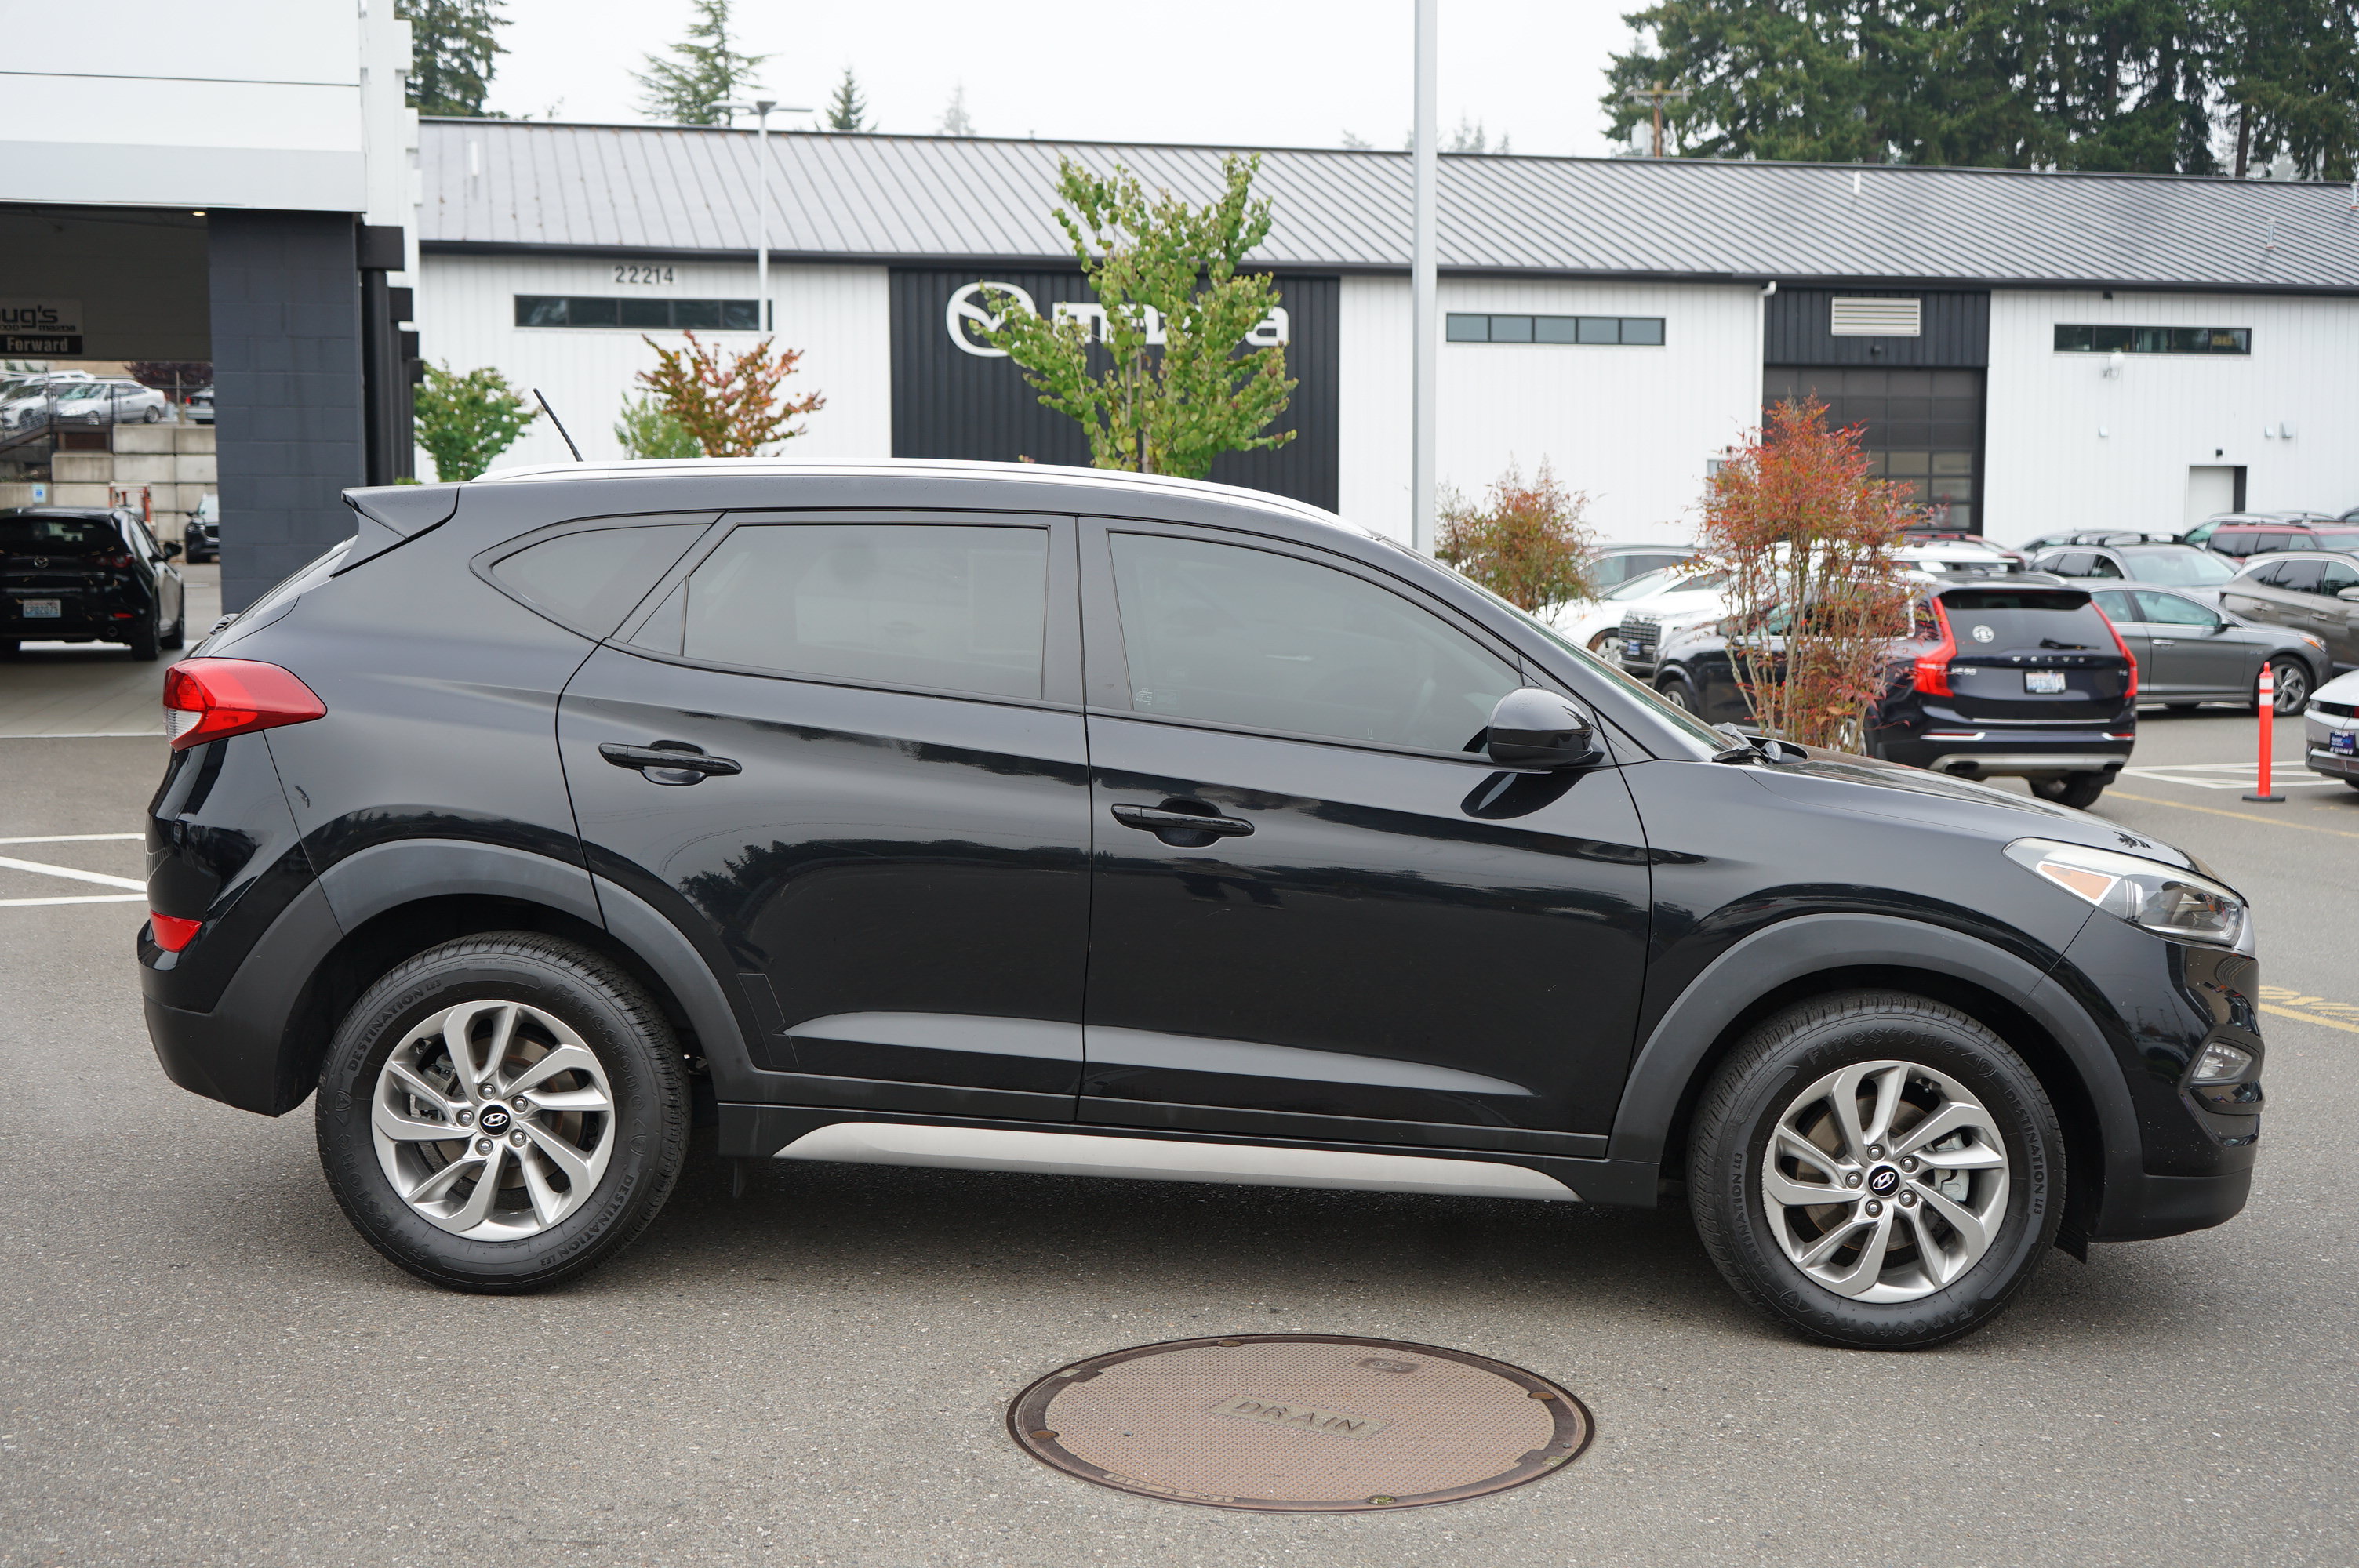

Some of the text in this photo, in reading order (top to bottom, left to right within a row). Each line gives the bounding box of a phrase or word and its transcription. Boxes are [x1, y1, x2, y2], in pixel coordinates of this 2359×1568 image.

[615, 265, 675, 285] 22214
[0, 304, 58, 328] ug's
[7, 336, 68, 352] Forward
[347, 989, 424, 1072] DESTINATION
[1802, 1026, 1956, 1066] Firestone
[2004, 1088, 2045, 1196] DESTINATION
[557, 1172, 635, 1258] DESTINATION
[1731, 1173, 1769, 1276] DESTINATION
[1233, 1399, 1365, 1432] DRAIN
